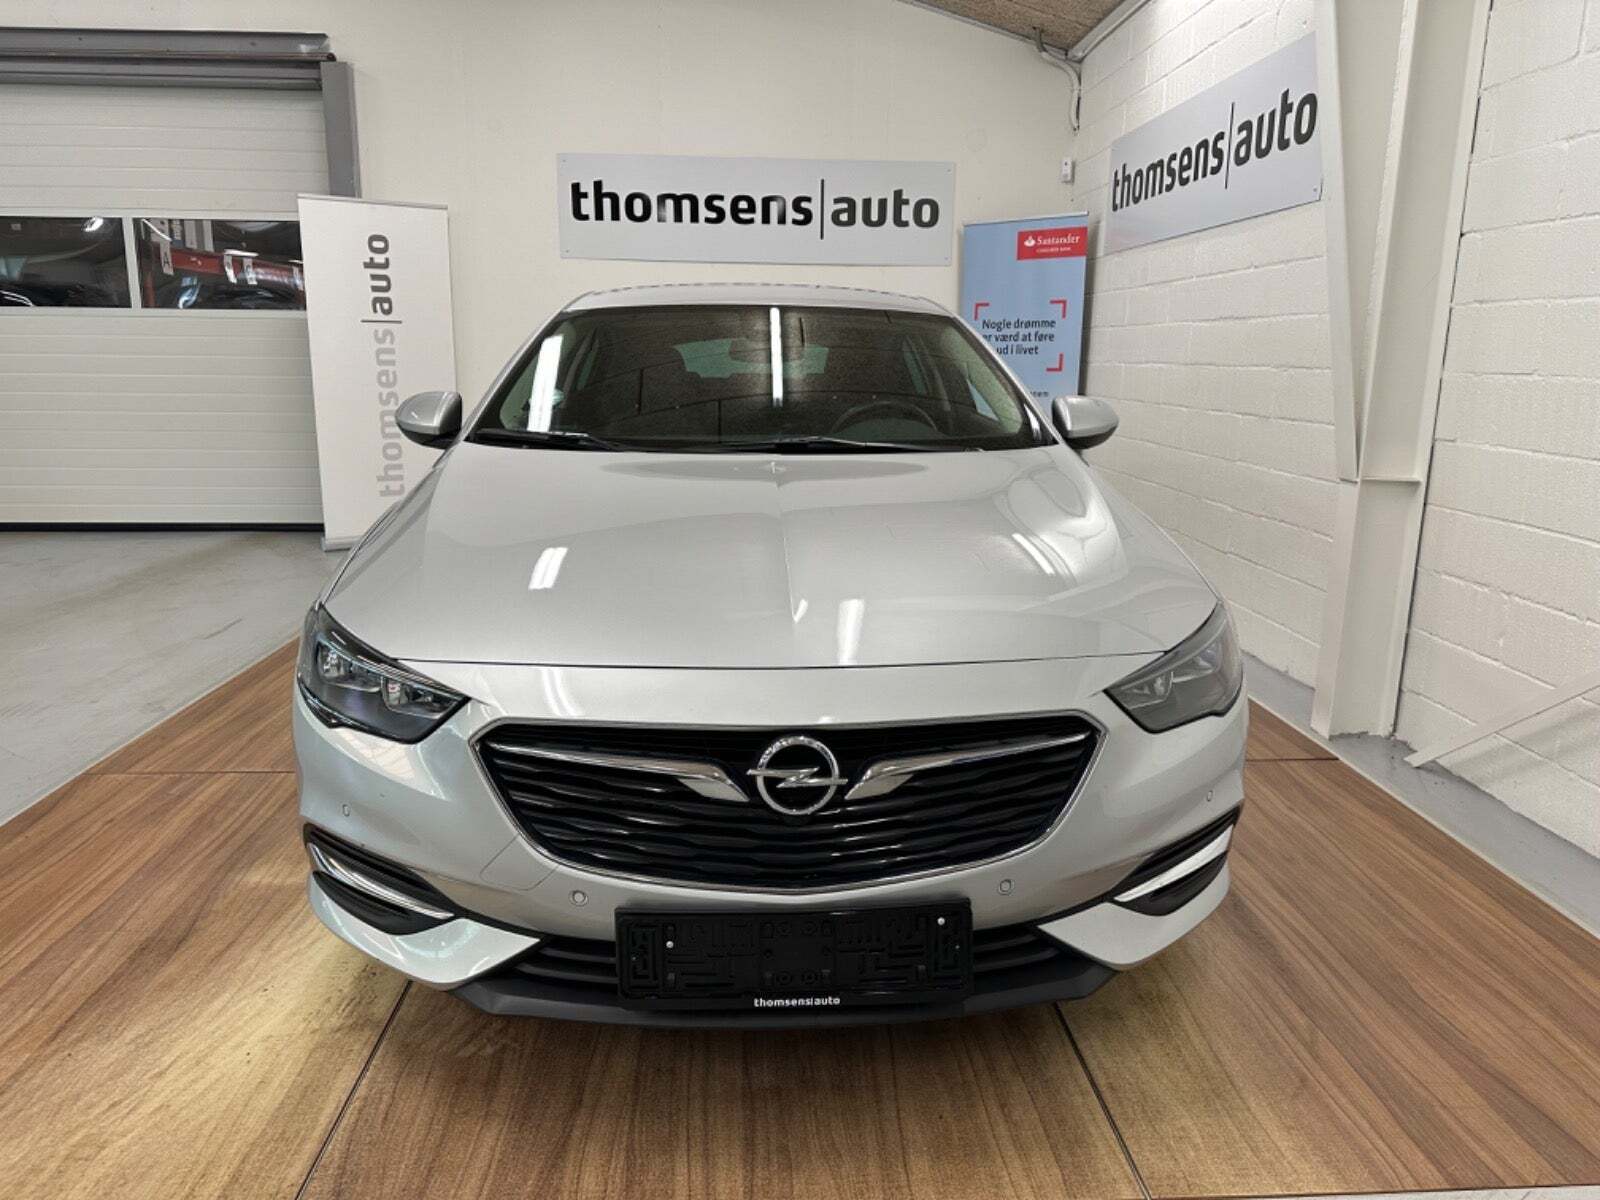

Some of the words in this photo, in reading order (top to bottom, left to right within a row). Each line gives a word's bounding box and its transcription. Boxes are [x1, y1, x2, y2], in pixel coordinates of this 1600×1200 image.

[1037, 233, 1080, 246] Santander
[982, 319, 1012, 332] Nogle
[1014, 318, 1056, 329] drømme
[995, 331, 1020, 342] værd
[1022, 332, 1032, 342] at
[1034, 331, 1055, 342] føre
[997, 345, 1009, 355] ud
[1016, 343, 1039, 355] livet
